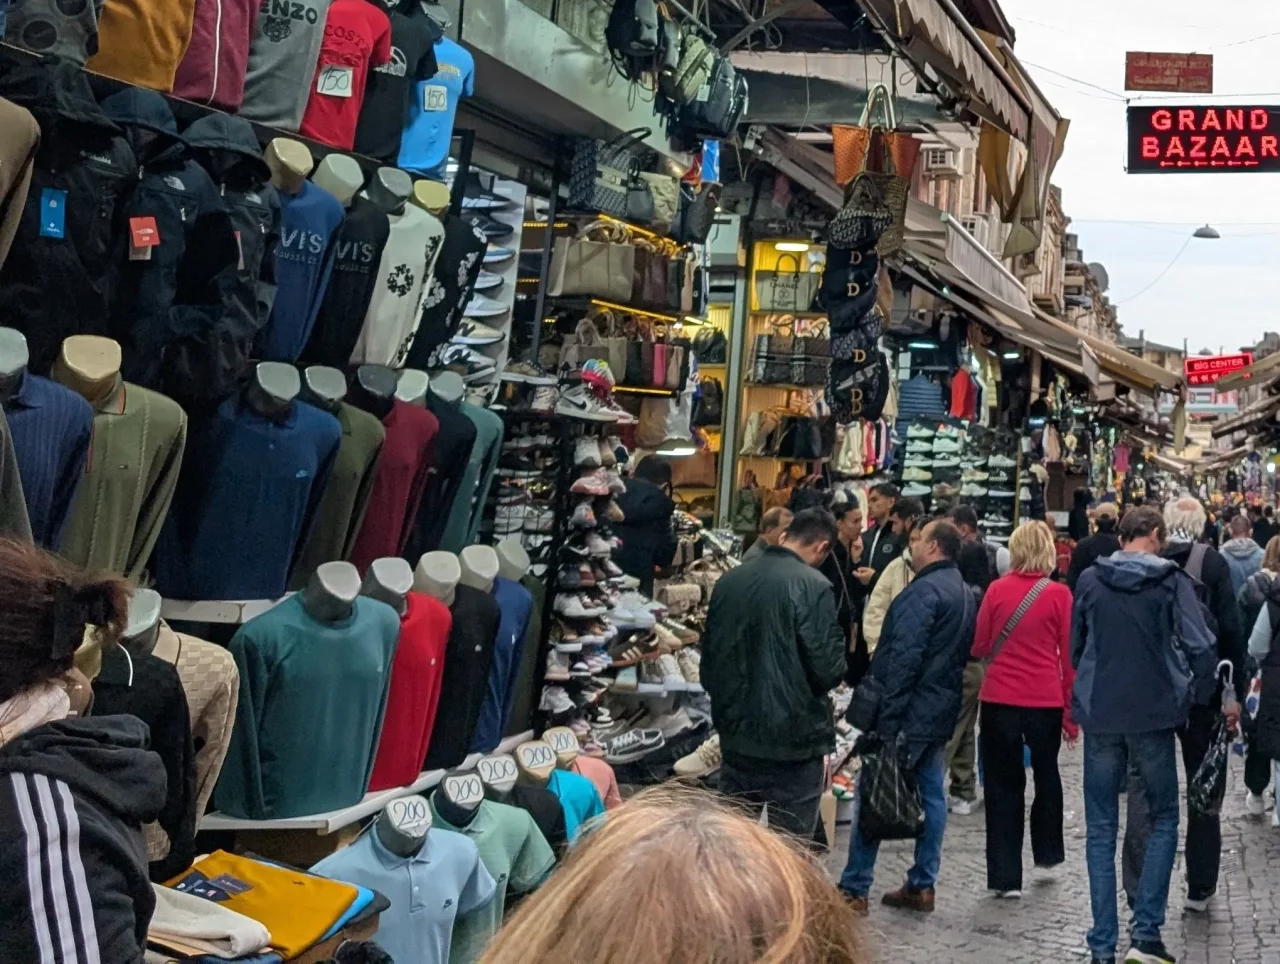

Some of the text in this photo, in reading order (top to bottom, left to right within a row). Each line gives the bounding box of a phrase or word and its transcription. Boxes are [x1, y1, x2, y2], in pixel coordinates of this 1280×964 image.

[321, 66, 349, 92] 150
[427, 88, 445, 108] 150
[1151, 109, 1268, 131] GRAND
[1142, 135, 1279, 158] BAZAAR
[847, 283, 860, 296] D
[853, 349, 867, 363] D
[1210, 358, 1244, 369] CENTER
[552, 731, 575, 751] 200
[522, 745, 552, 768] 200
[481, 760, 516, 781] 200
[449, 779, 480, 803] 200
[393, 800, 426, 827] 200
